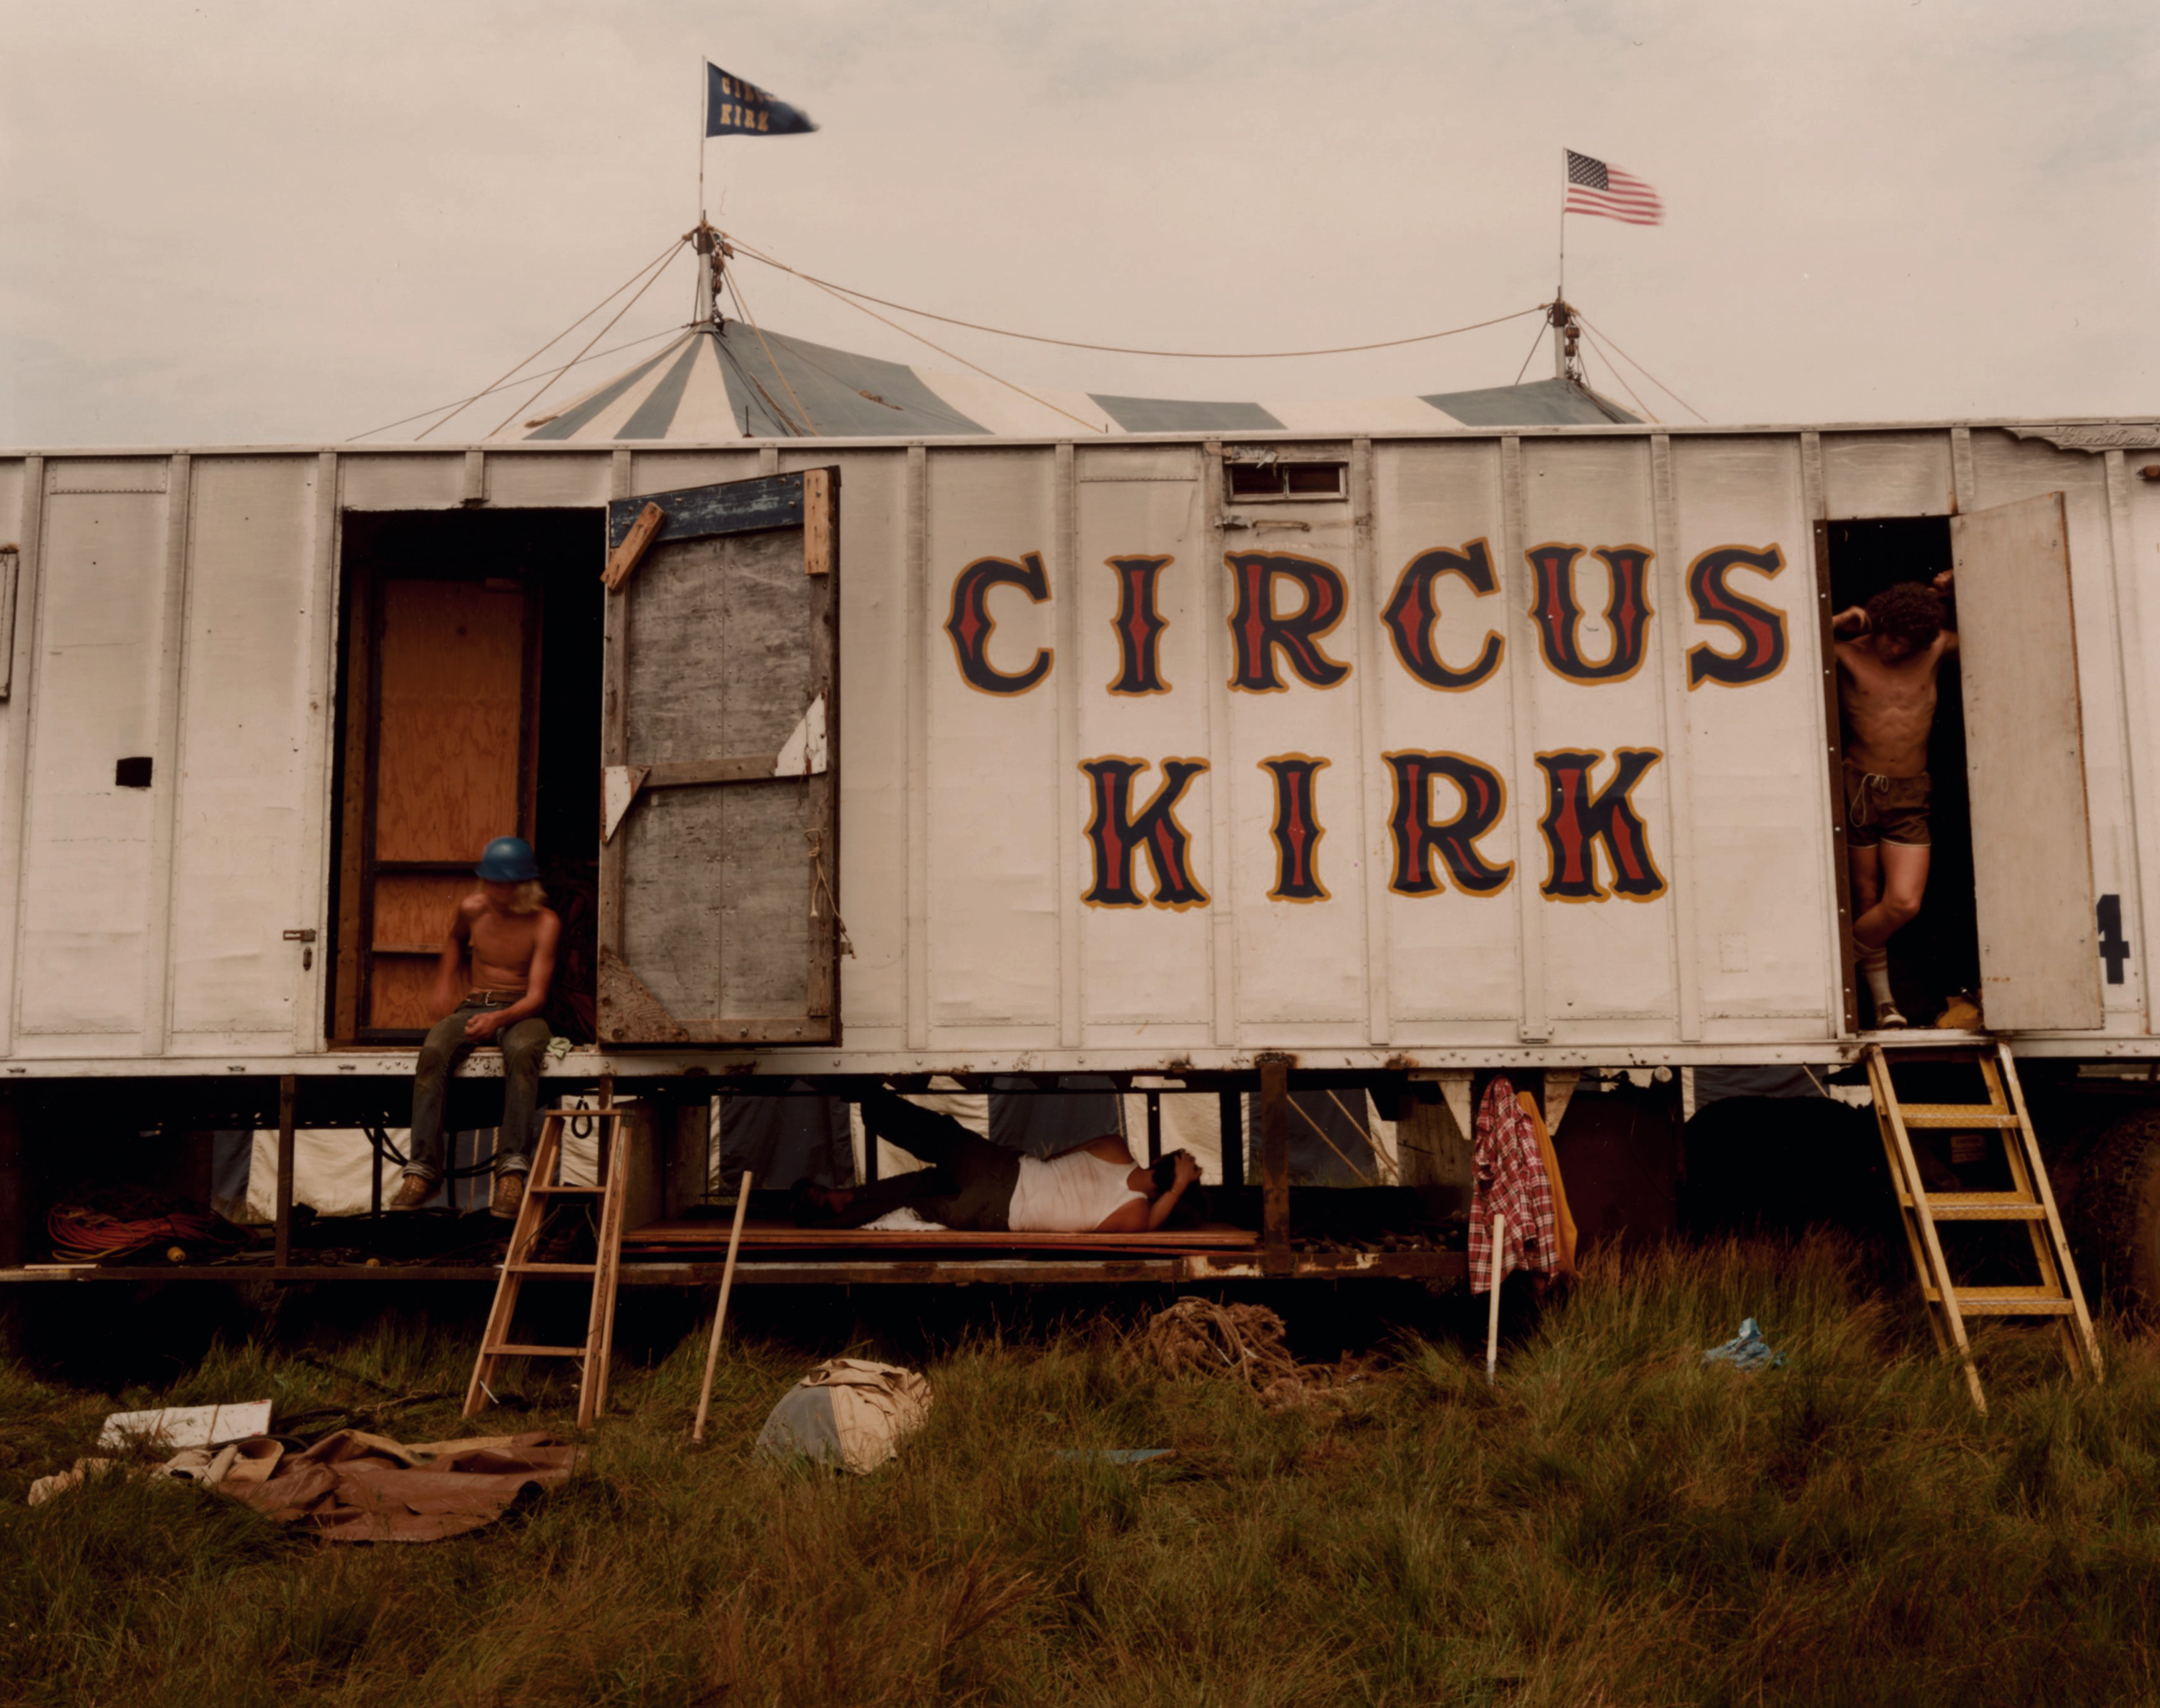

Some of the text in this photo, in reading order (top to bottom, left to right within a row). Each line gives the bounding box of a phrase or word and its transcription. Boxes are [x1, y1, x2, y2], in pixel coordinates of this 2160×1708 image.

[720, 103, 769, 131] KIRK
[943, 536, 1790, 698] CIRCUS
[1077, 747, 1670, 913] KIRK
